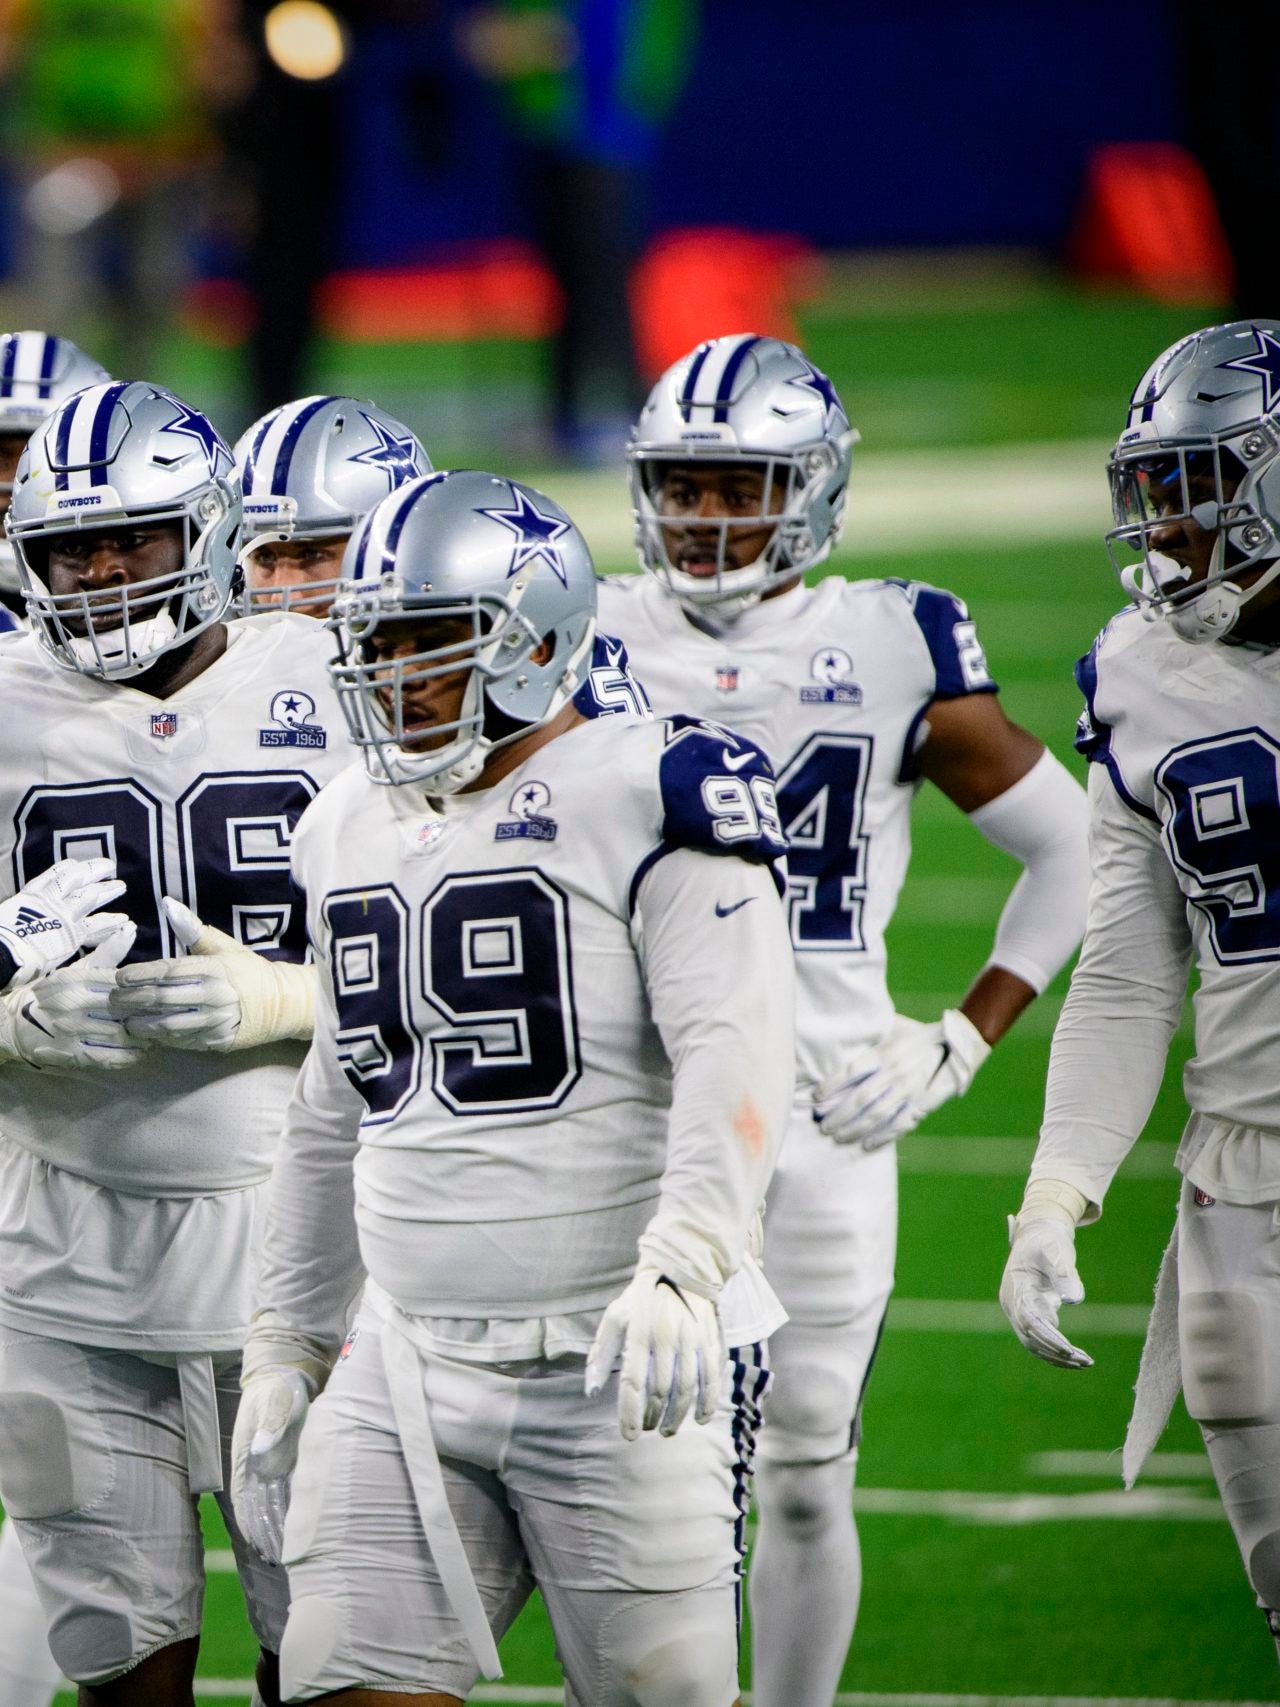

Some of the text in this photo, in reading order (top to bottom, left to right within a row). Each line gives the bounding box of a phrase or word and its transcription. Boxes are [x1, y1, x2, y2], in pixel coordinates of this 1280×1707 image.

[58, 496, 102, 509] COWBOYS
[261, 732, 325, 746] EST. 1960
[700, 776, 789, 849] 99
[497, 823, 556, 839] EST. 1960
[15, 919, 63, 939] adidas
[322, 865, 583, 1127] 99
